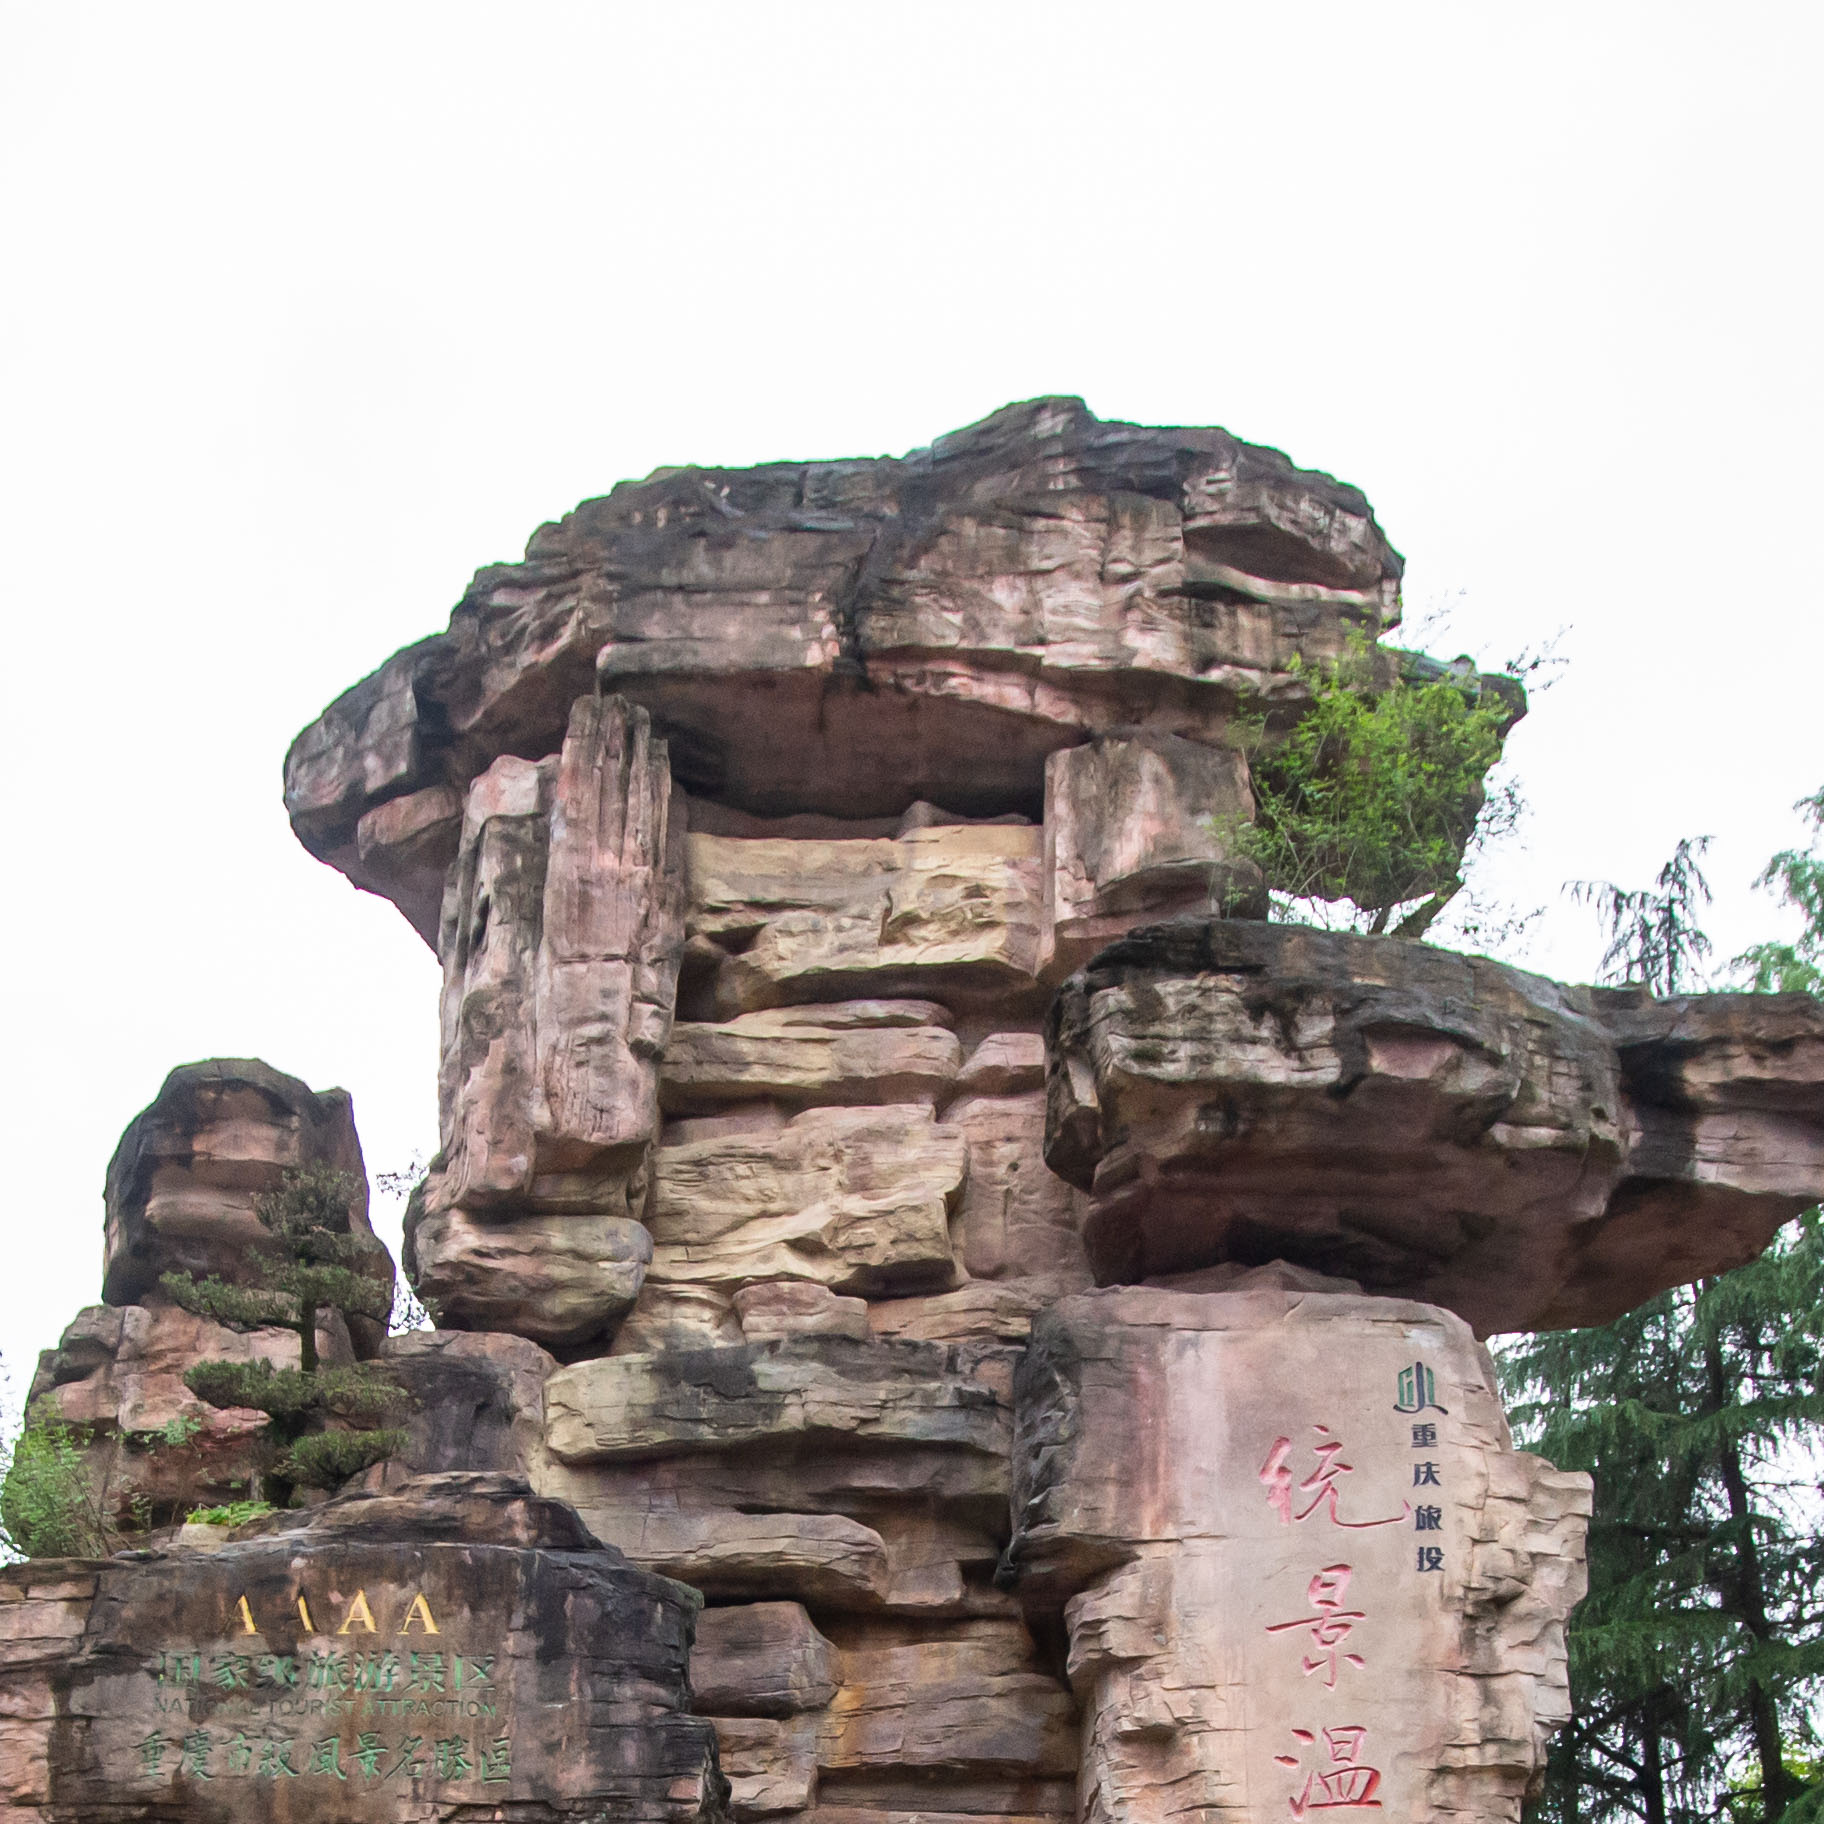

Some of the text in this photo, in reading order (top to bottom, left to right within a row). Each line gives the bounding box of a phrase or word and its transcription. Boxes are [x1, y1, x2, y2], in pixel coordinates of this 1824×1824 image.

[1411, 1423, 1445, 1572] 重庆旅投
[158, 1650, 496, 1692] 国家级旅游景区
[267, 1697, 356, 1717] TOURIST
[361, 1698, 496, 1719] ATTRACTION
